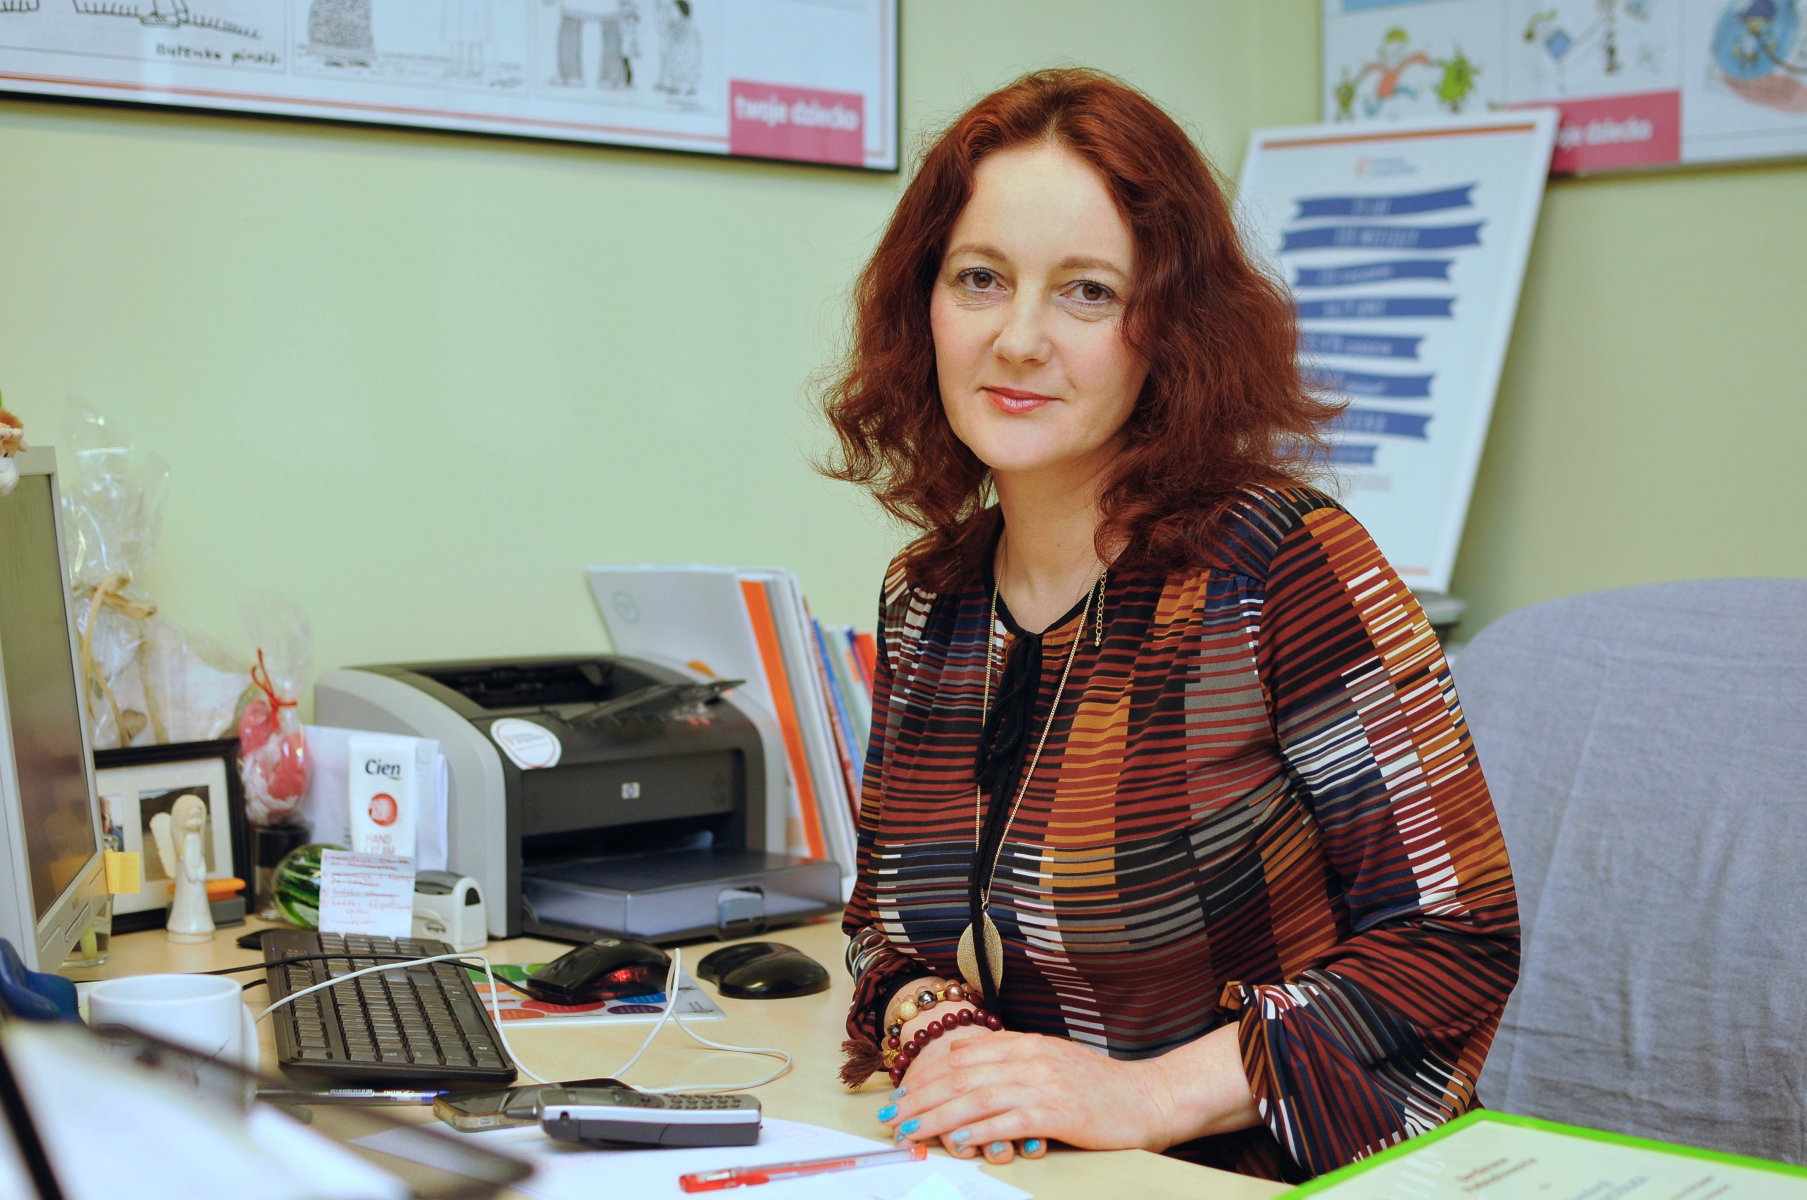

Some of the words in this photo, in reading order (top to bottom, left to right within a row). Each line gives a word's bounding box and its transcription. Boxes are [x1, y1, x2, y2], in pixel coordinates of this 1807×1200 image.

[735, 94, 787, 128] twoje
[791, 98, 859, 131] dziecko
[365, 758, 401, 776] Cien
